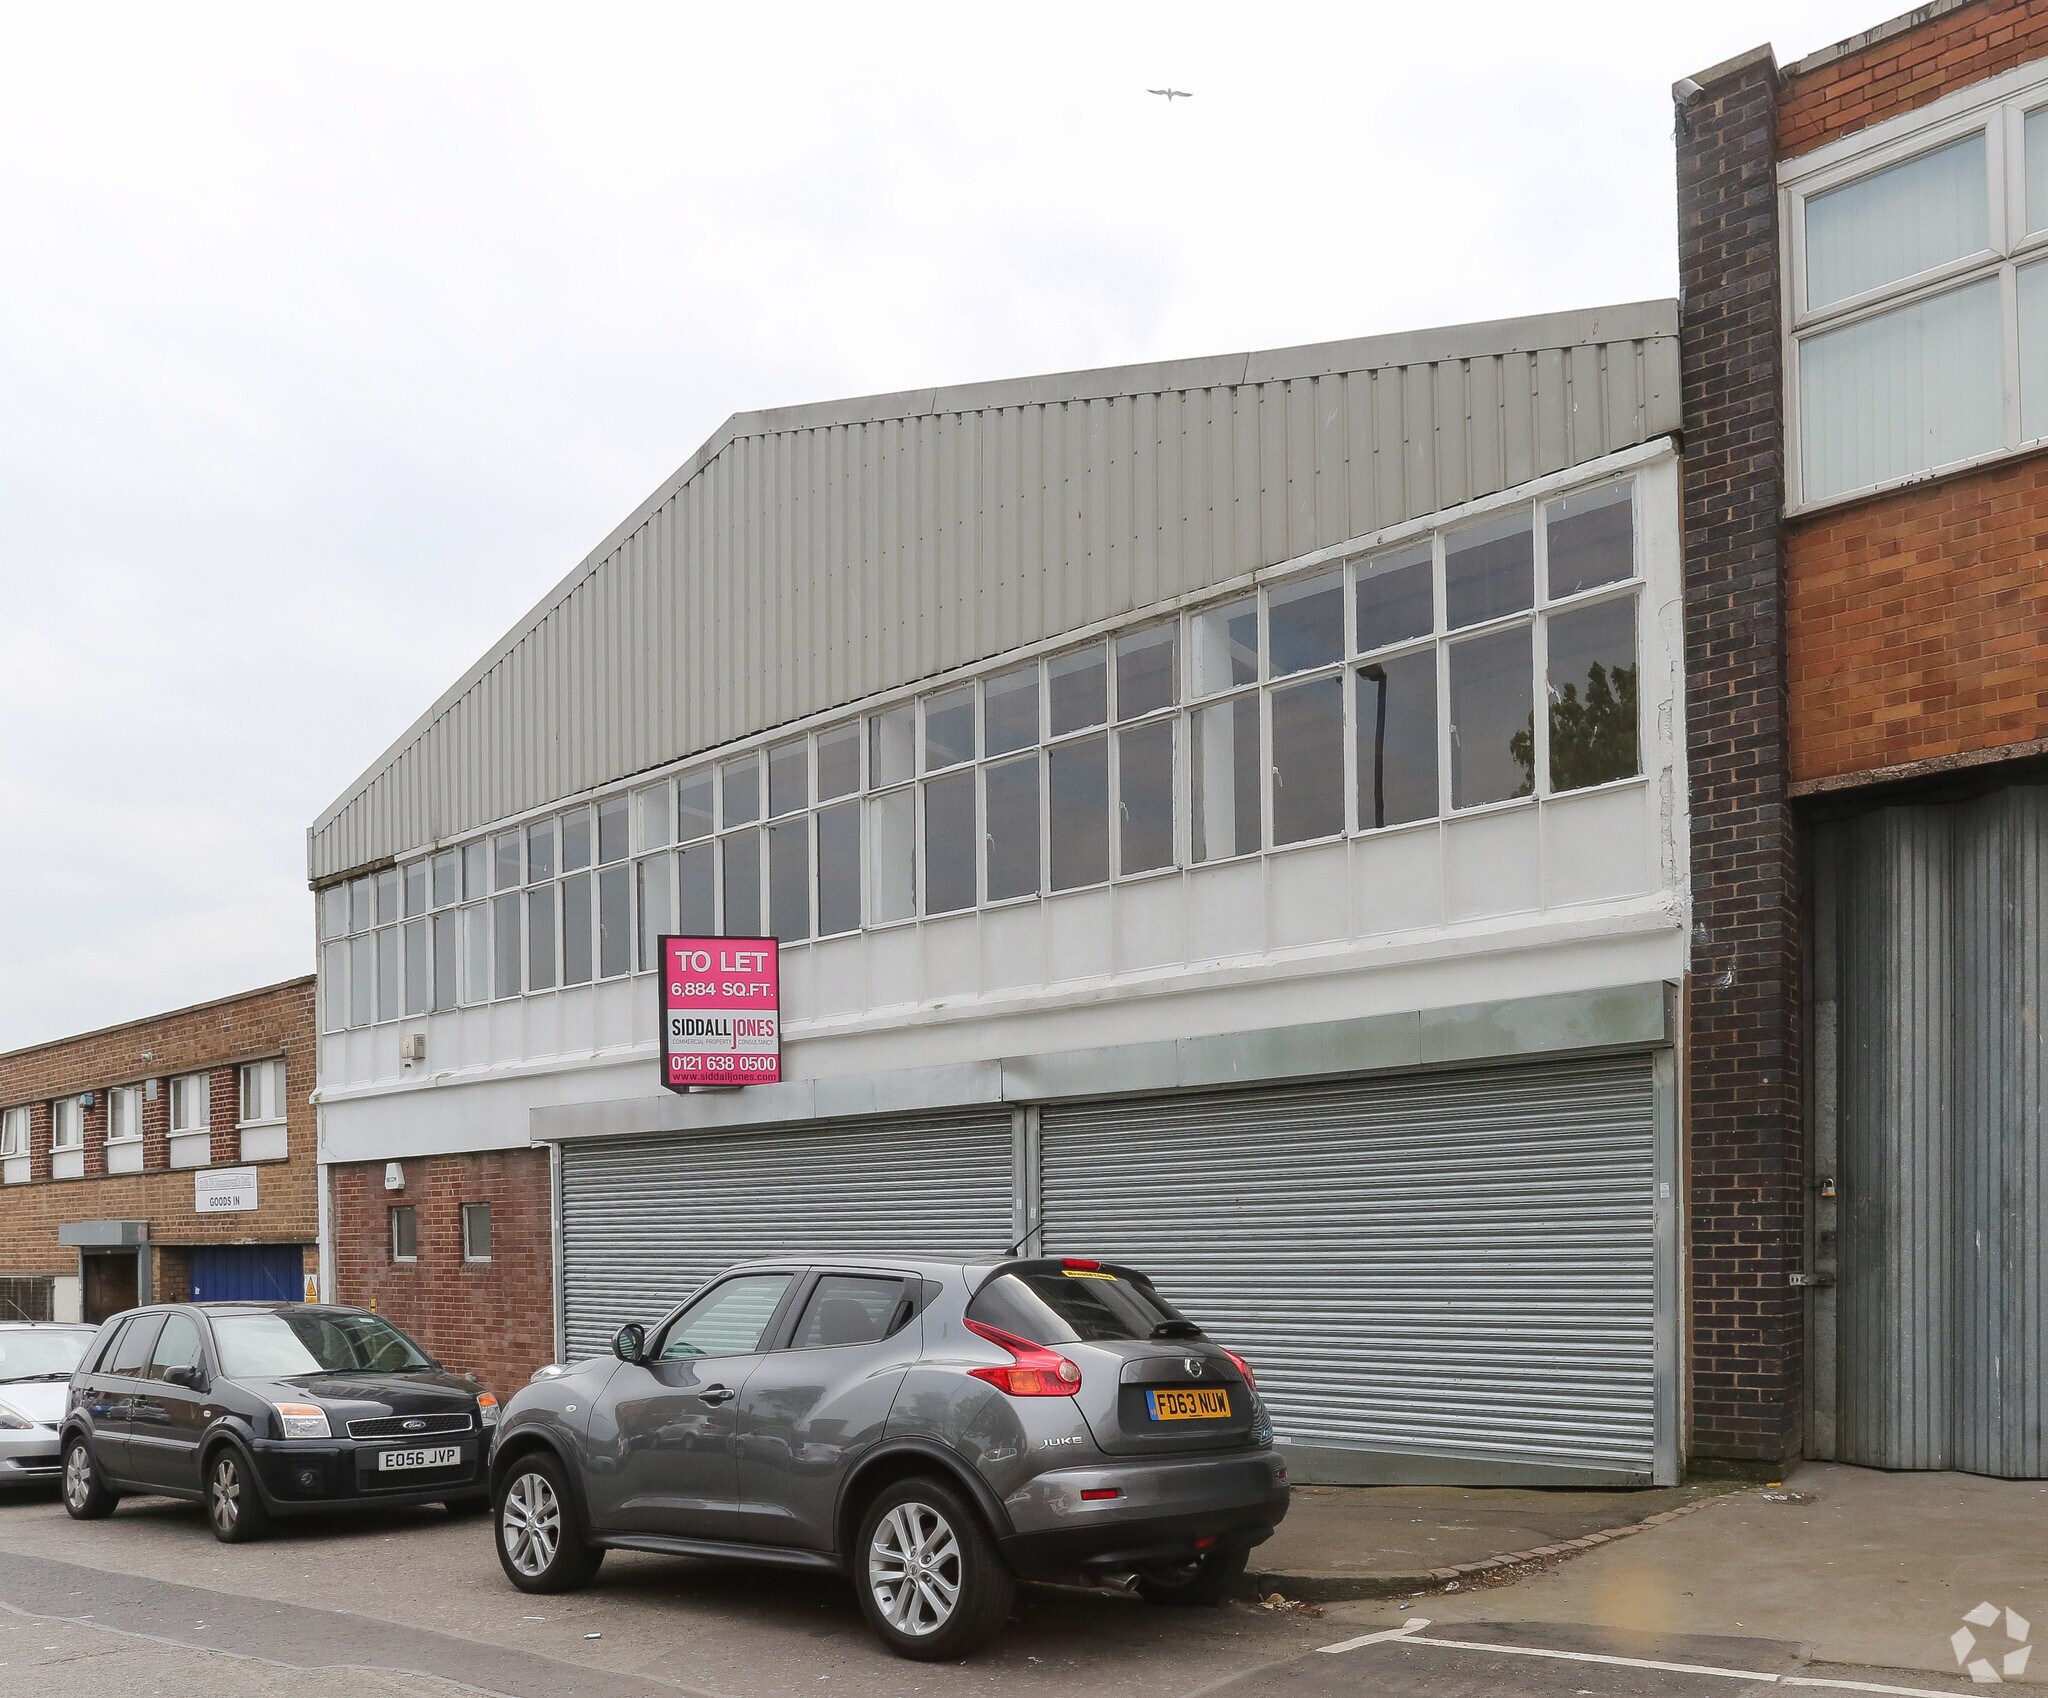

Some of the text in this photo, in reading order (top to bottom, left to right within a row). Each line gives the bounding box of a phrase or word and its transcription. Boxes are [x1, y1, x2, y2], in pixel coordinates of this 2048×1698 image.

[675, 951, 768, 973] TO LET
[671, 982, 774, 997] 6,884 SQ.FT.
[672, 1018, 775, 1050] SIDDALL JONES
[671, 1056, 776, 1071] 0121 638 0500
[672, 1072, 776, 1082] www.siddalljones.com
[210, 1196, 240, 1207] GOODS IN
[1157, 1392, 1227, 1415] FD63 NUW
[1039, 1436, 1083, 1450] JUKE
[429, 1449, 455, 1464] JVP
